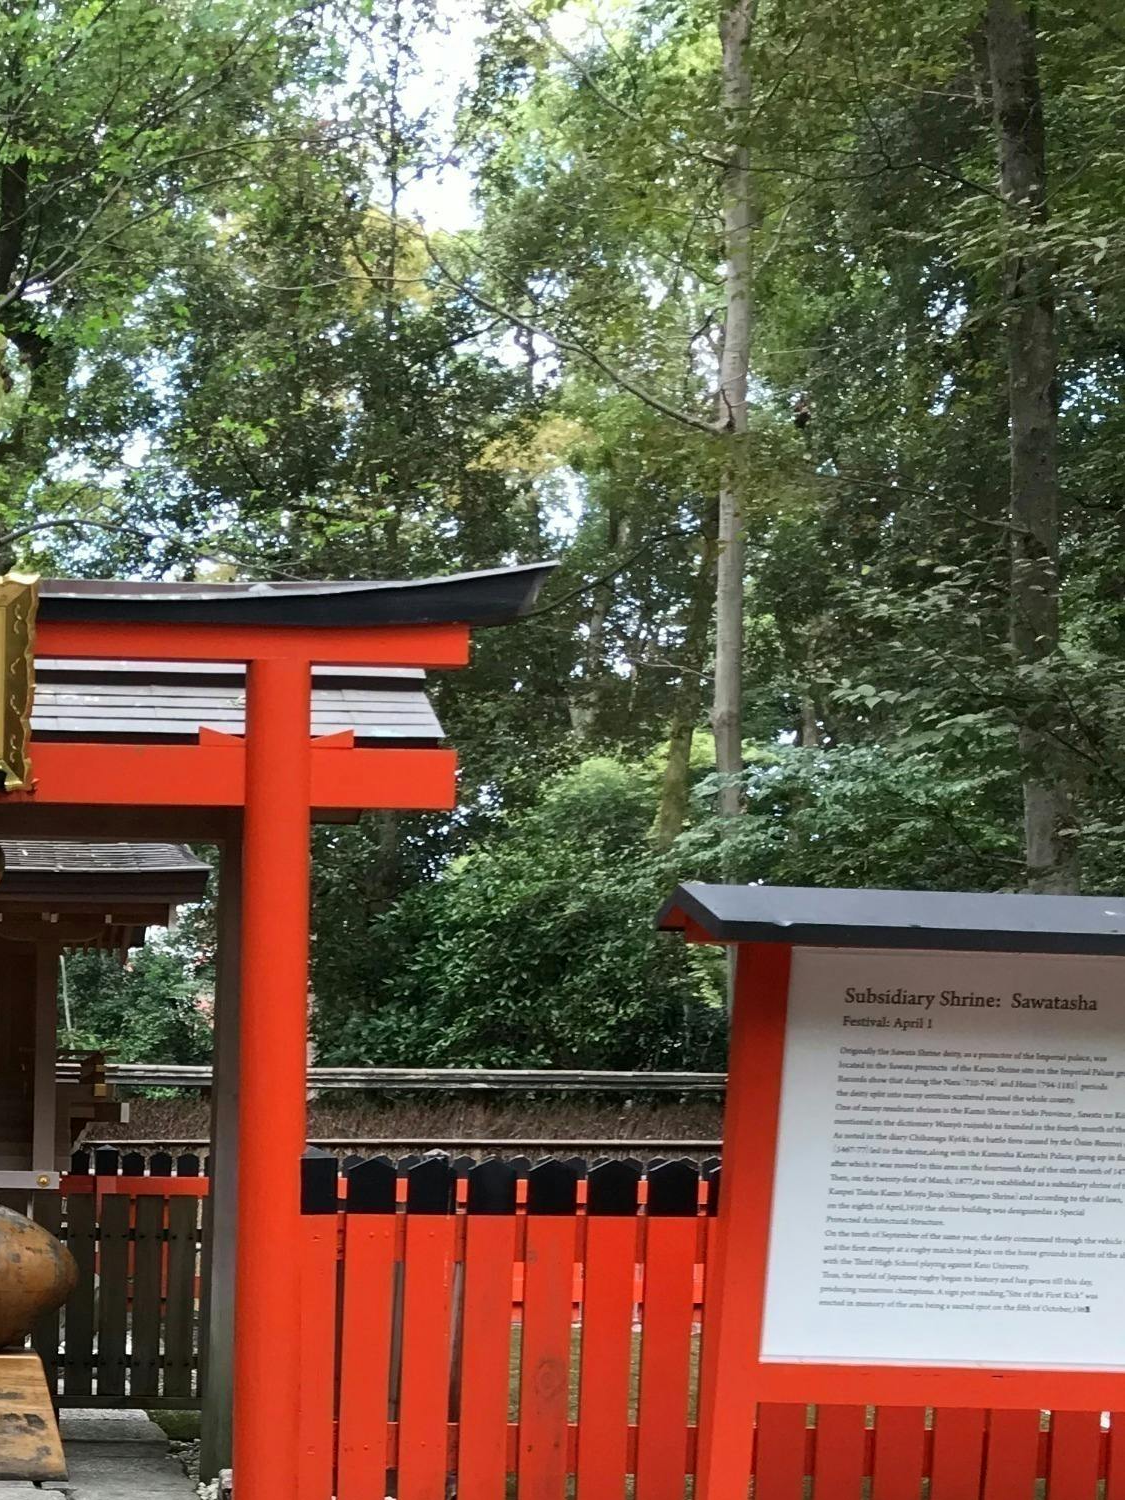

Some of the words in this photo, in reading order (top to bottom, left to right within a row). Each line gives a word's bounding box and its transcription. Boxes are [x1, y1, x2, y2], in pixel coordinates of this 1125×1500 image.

[844, 988, 935, 1010] Subsidiary
[939, 990, 1001, 1008] Shrine:
[1011, 993, 1098, 1011] Sawatasha
[843, 1016, 890, 1028] Festival:
[893, 1017, 924, 1031] April
